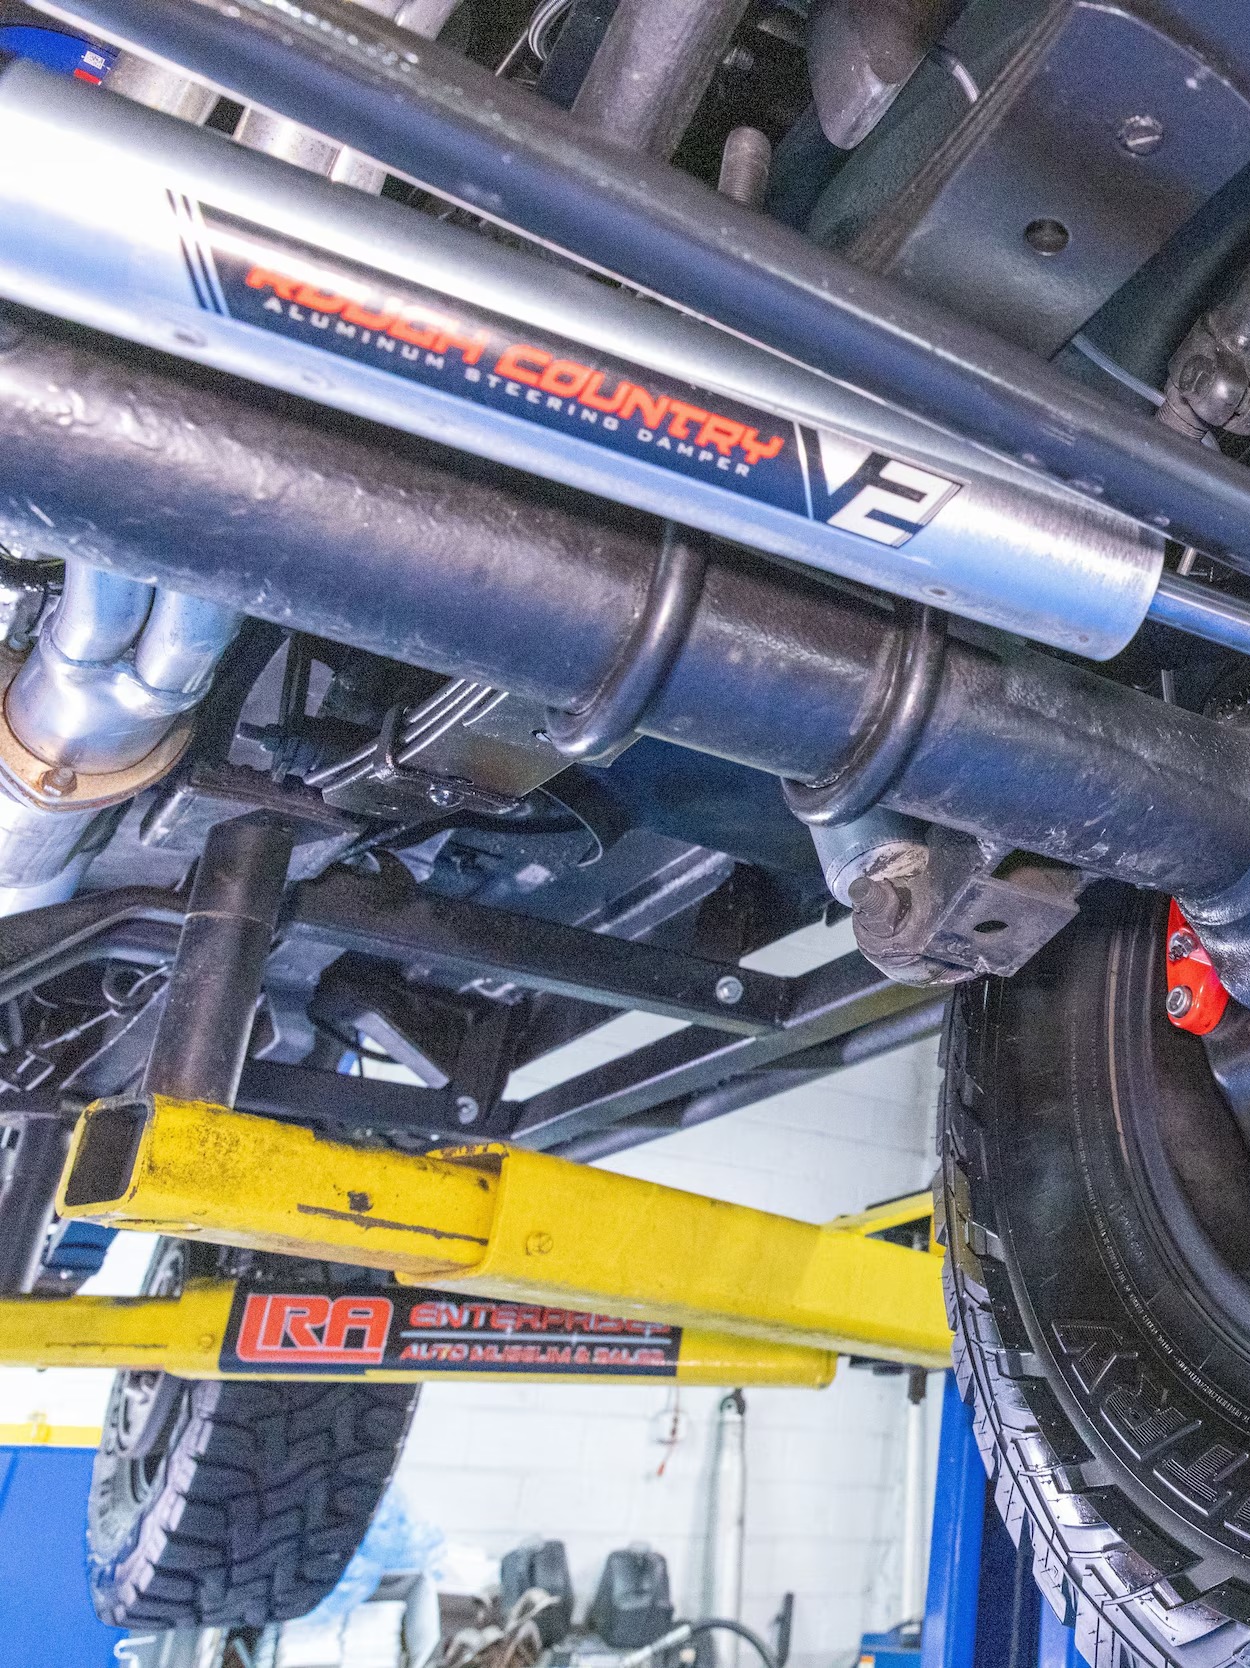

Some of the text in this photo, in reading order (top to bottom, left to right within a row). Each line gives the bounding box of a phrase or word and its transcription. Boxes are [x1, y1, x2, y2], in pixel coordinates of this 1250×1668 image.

[262, 295, 751, 478] ALUMINUM STEERING DAMPER
[494, 343, 785, 466] COUNTRY
[798, 420, 965, 549] V2
[236, 1293, 394, 1365] LRA
[399, 1342, 469, 1361] AUTO
